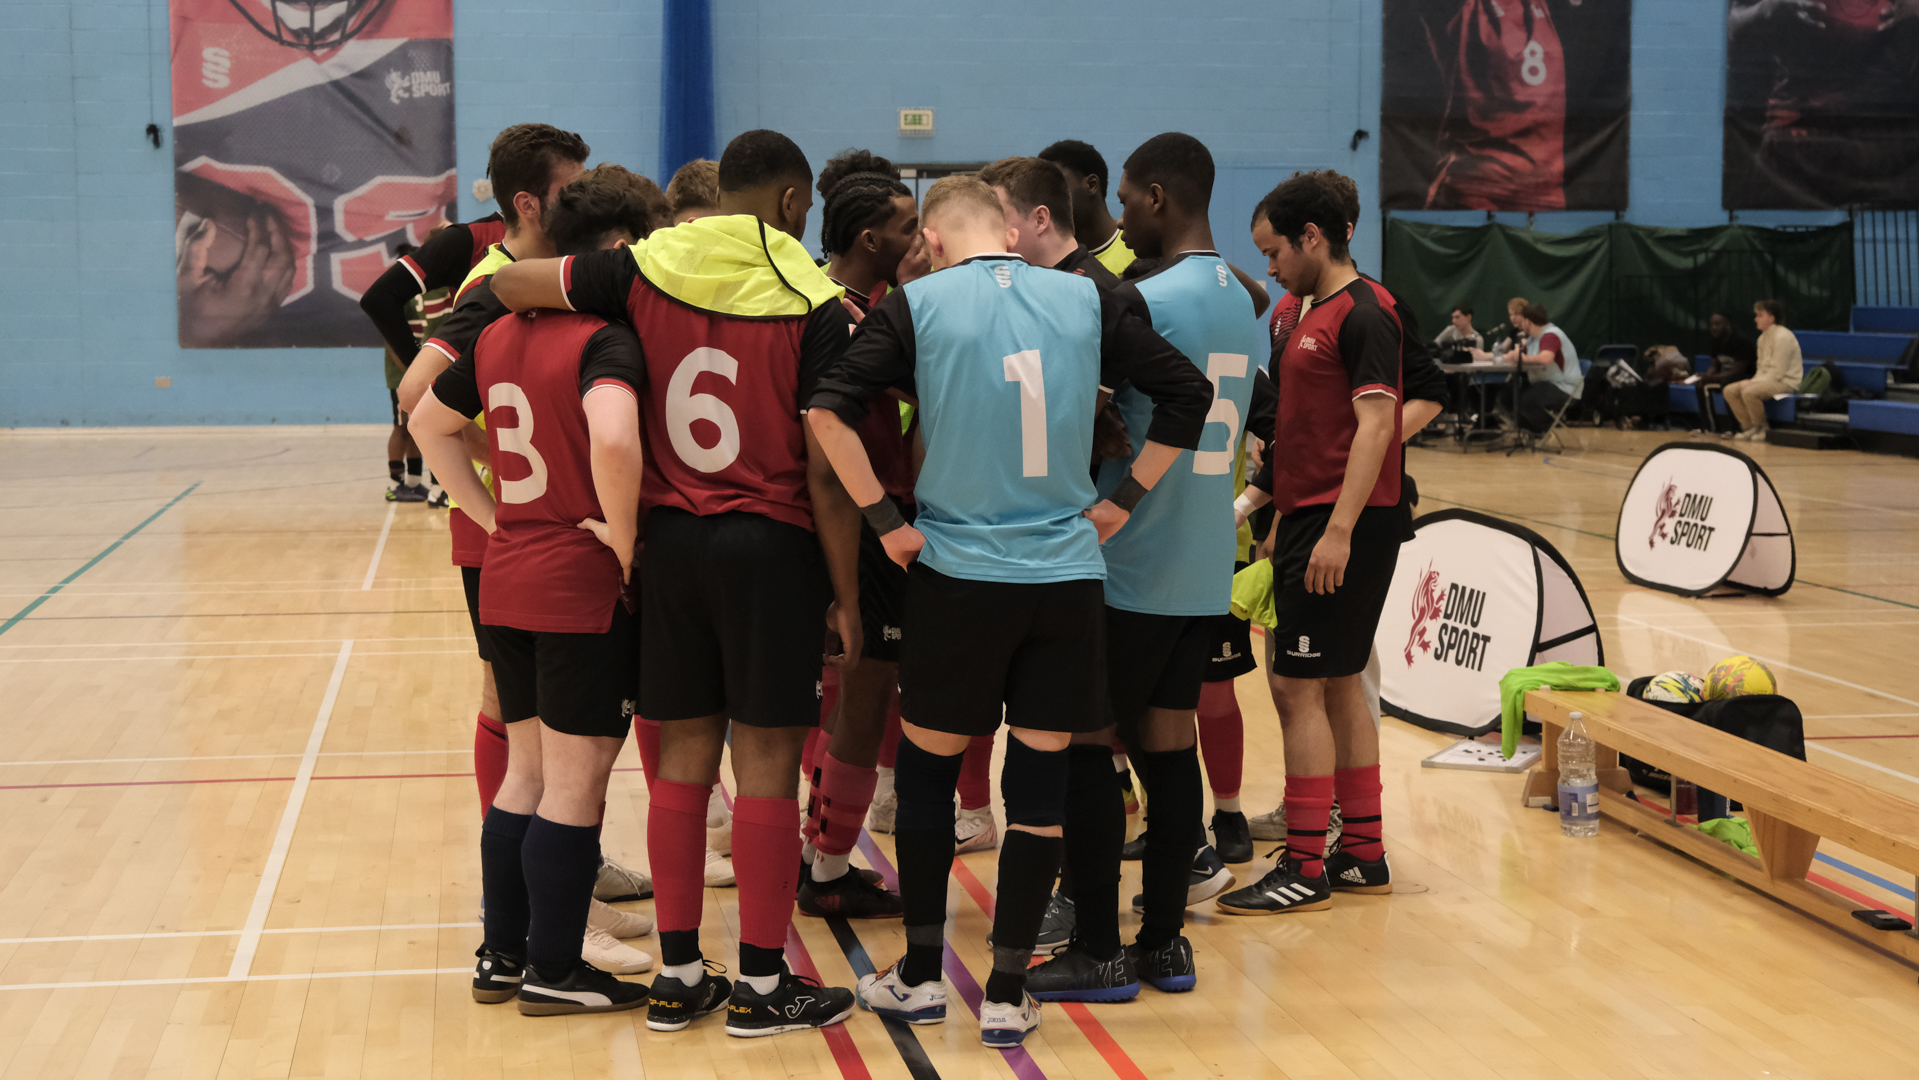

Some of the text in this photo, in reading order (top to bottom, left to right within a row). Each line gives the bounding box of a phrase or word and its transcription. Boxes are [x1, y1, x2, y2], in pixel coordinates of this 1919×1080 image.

[410, 71, 441, 84] DMU
[1521, 40, 1547, 86] 8
[412, 82, 451, 98] SPORT
[665, 346, 740, 473] 6
[1003, 349, 1048, 477] 1
[1192, 352, 1249, 475] 5
[488, 382, 548, 504] 3
[1678, 493, 1713, 522] DMU
[1670, 520, 1716, 552] SPORT
[1443, 582, 1487, 628] DMU
[1433, 622, 1492, 672] SPORT
[1340, 873, 1367, 884] adidas
